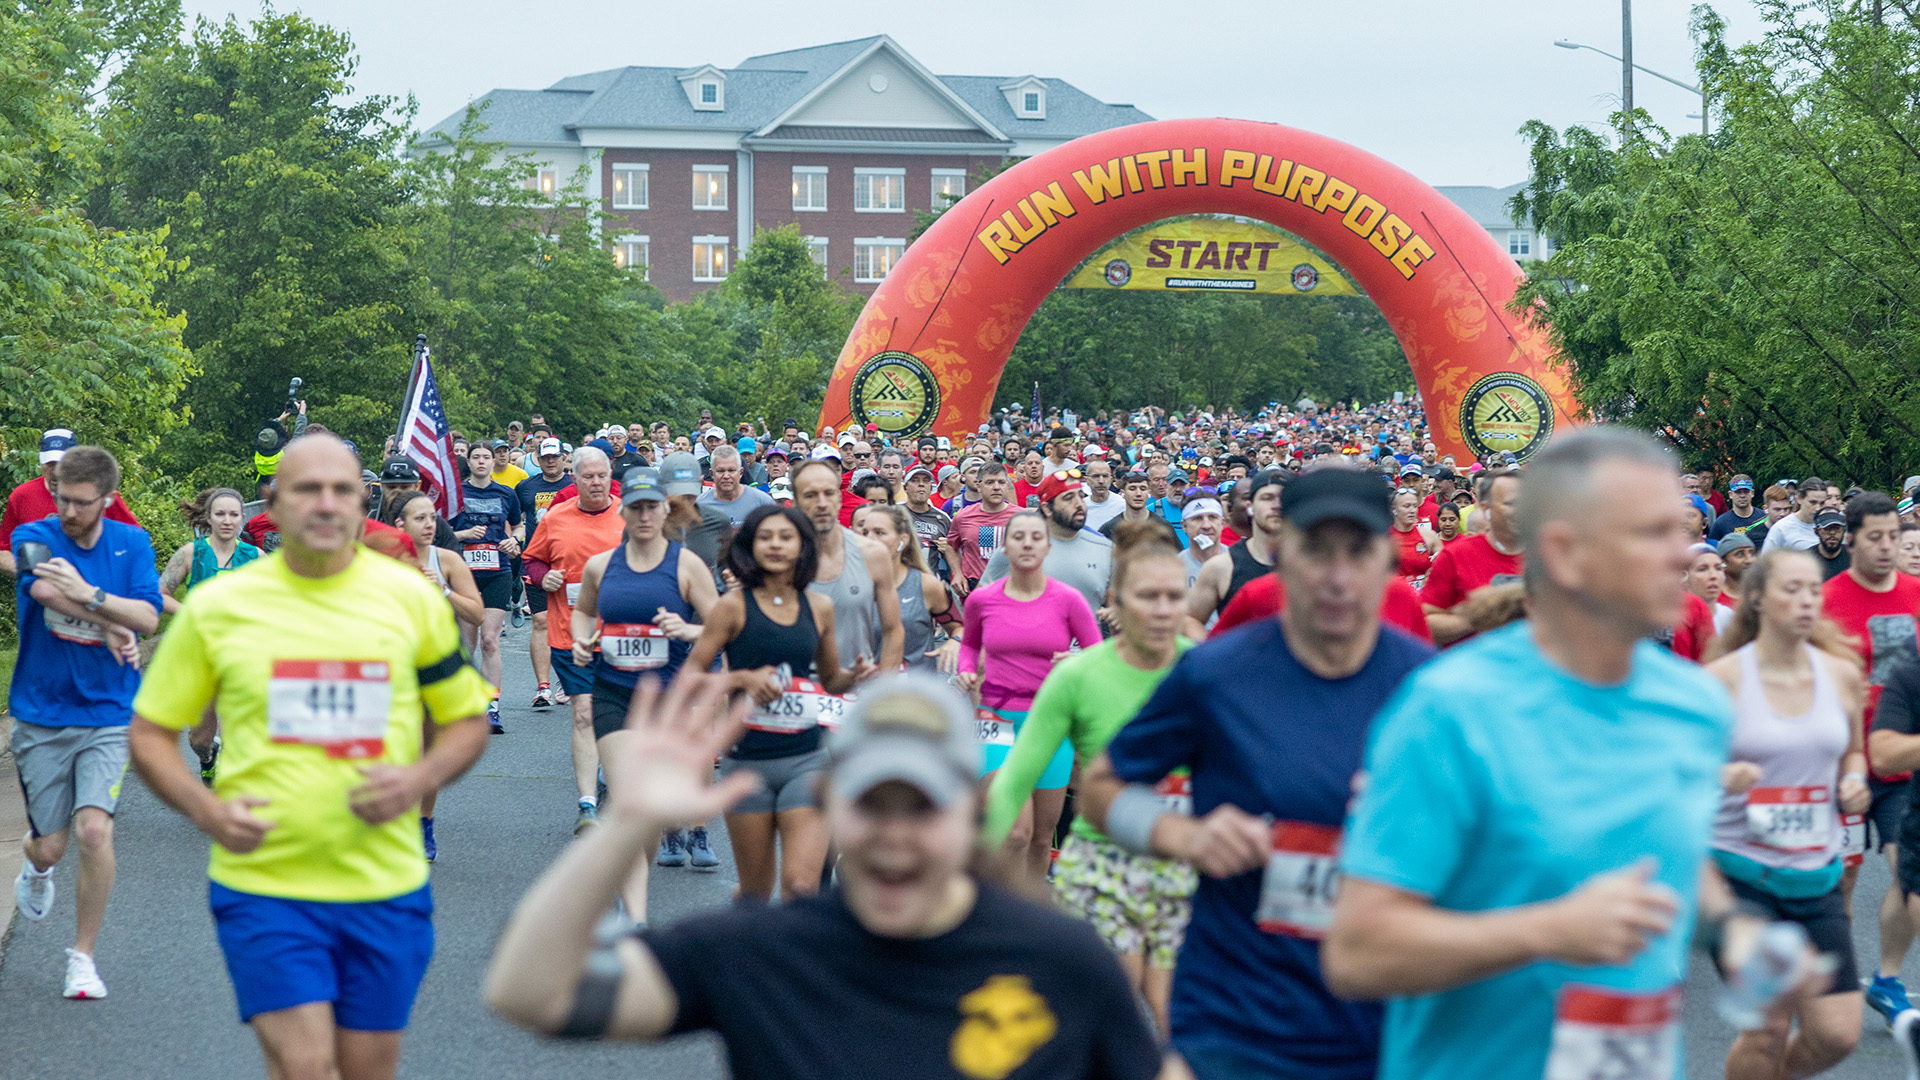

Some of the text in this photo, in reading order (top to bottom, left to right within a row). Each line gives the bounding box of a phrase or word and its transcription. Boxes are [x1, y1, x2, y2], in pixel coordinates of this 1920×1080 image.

[977, 148, 1436, 280] RUN WITH PURPOSE
[1146, 239, 1279, 271] START
[1168, 279, 1254, 288] #RUNWITHTHEMARINES
[471, 551, 491, 562] 1961
[616, 638, 651, 656] 1180
[304, 684, 355, 715] 444
[817, 696, 843, 716] 543
